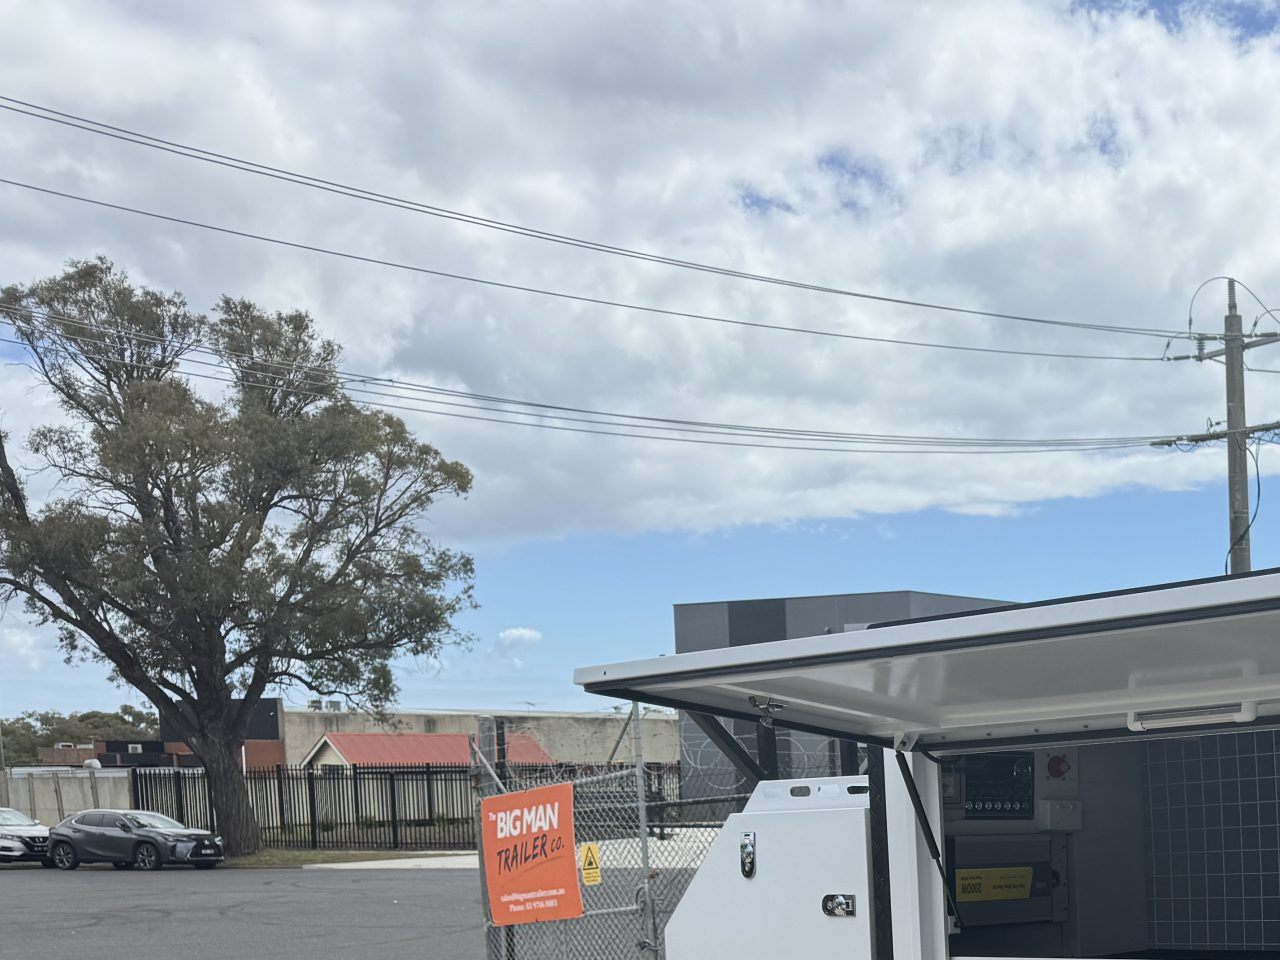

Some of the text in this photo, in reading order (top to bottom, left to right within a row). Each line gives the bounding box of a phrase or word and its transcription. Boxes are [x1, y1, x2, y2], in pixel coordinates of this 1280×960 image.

[497, 809, 521, 839] BIG
[523, 801, 559, 835] MAN
[496, 833, 564, 876] TRAILER CO.
